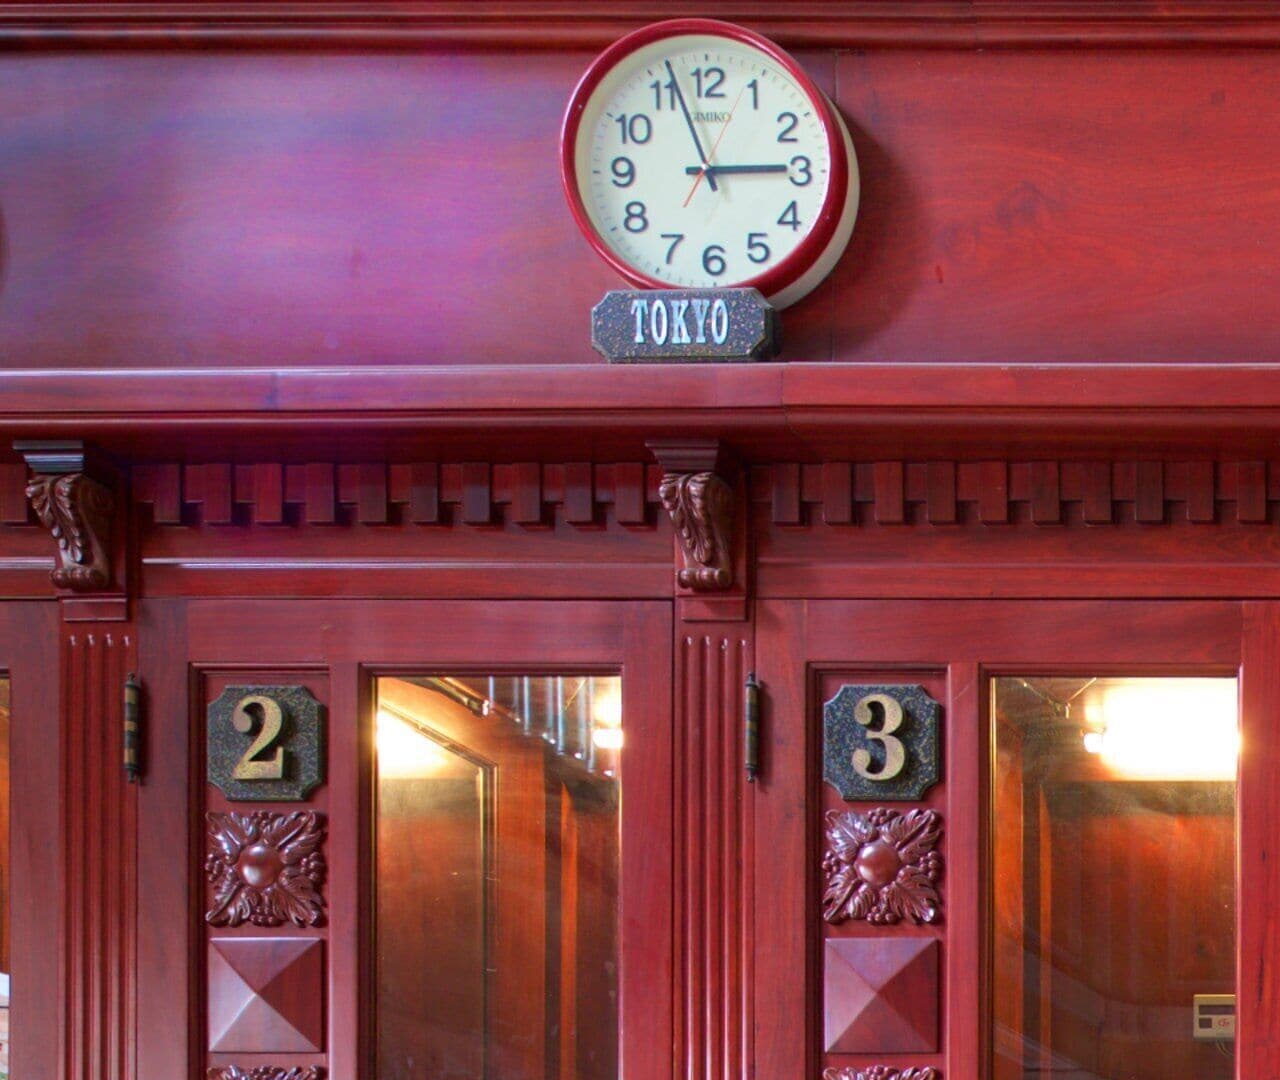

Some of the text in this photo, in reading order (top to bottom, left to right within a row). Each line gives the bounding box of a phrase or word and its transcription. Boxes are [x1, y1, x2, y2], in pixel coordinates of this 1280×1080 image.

[650, 80, 677, 110] 11
[691, 68, 725, 97] 12
[748, 80, 758, 110] 1
[616, 114, 651, 144] 10
[777, 113, 798, 142] 2
[611, 157, 635, 187] 9
[789, 156, 812, 186] 3
[624, 202, 648, 232] 8
[777, 201, 800, 230] 4
[661, 234, 684, 265] 7
[702, 245, 726, 276] 6
[747, 233, 770, 263] 5
[631, 299, 729, 345] TOKYO
[233, 695, 284, 780] 2
[851, 693, 906, 781] 3
